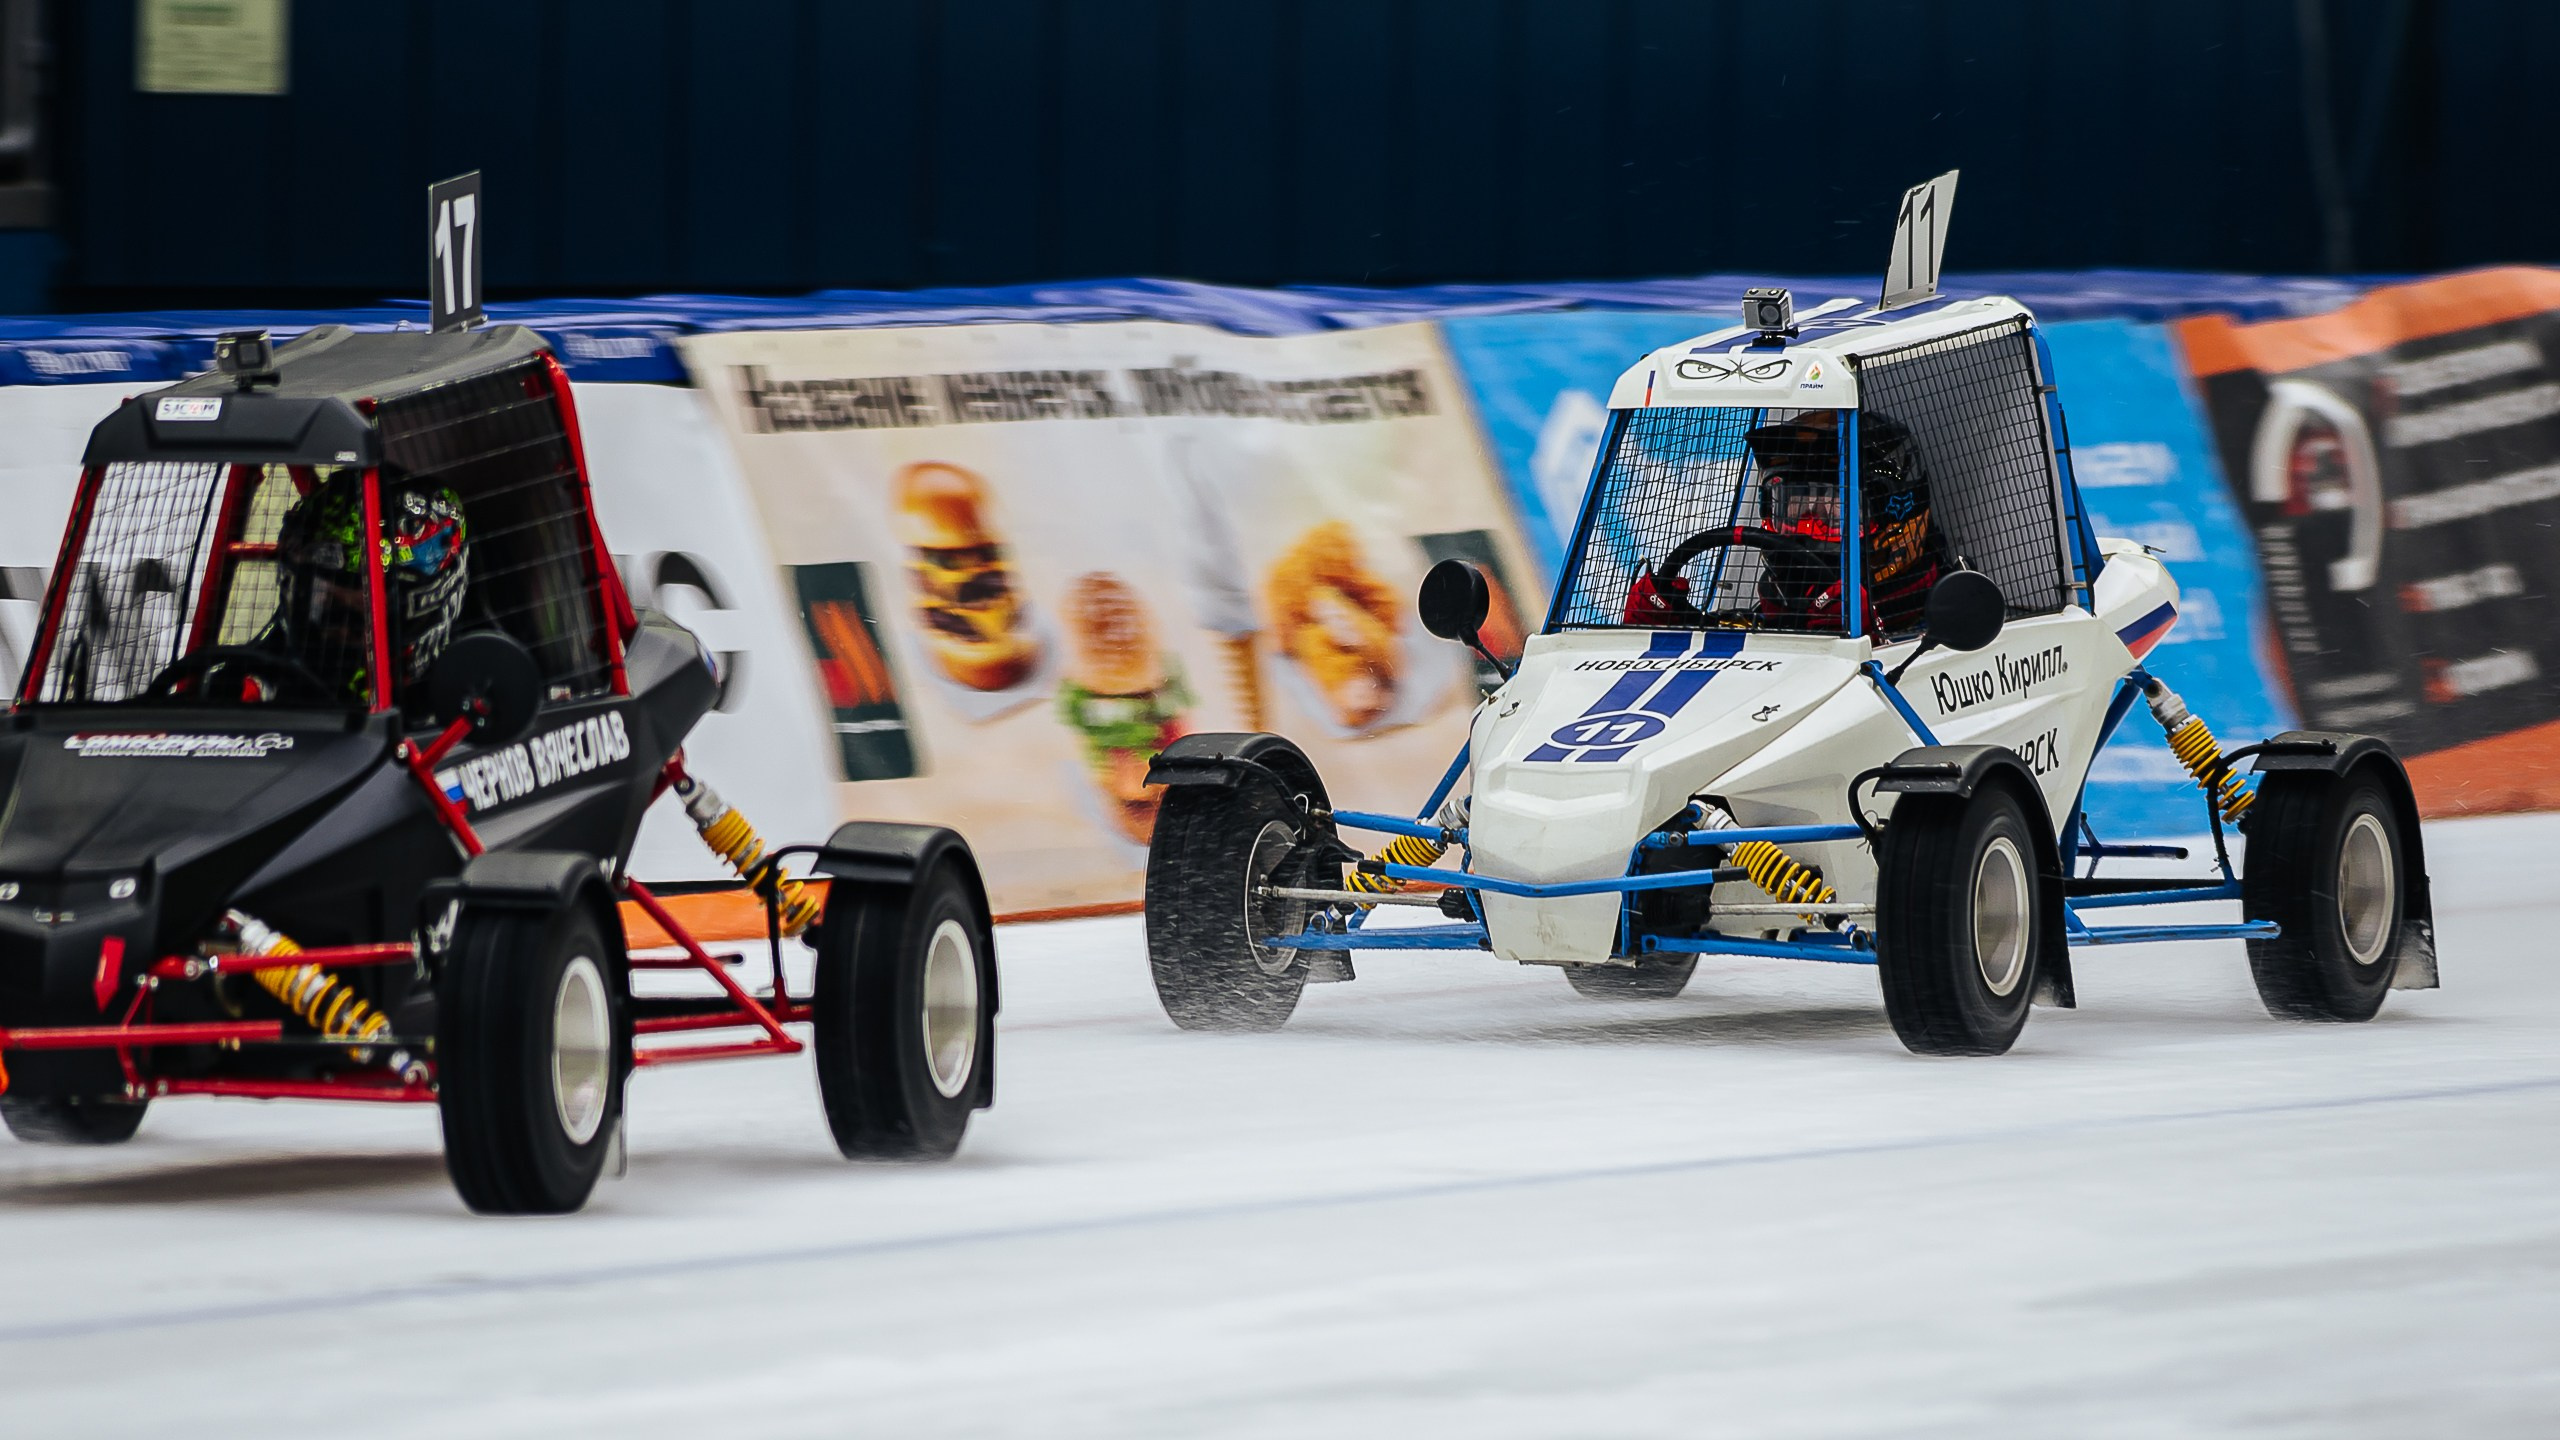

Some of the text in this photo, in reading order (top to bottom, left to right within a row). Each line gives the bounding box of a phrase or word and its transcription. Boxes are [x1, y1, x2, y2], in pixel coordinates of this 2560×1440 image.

[435, 193, 475, 315] 17
[1899, 184, 1935, 290] 11
[1574, 659, 1782, 671] НОВОСИБИРСК
[1930, 670, 1994, 715] Юшко
[458, 710, 630, 811] ЧЕРНОВ ВЯЧЕСЛАВ
[1574, 720, 1647, 742] 11
